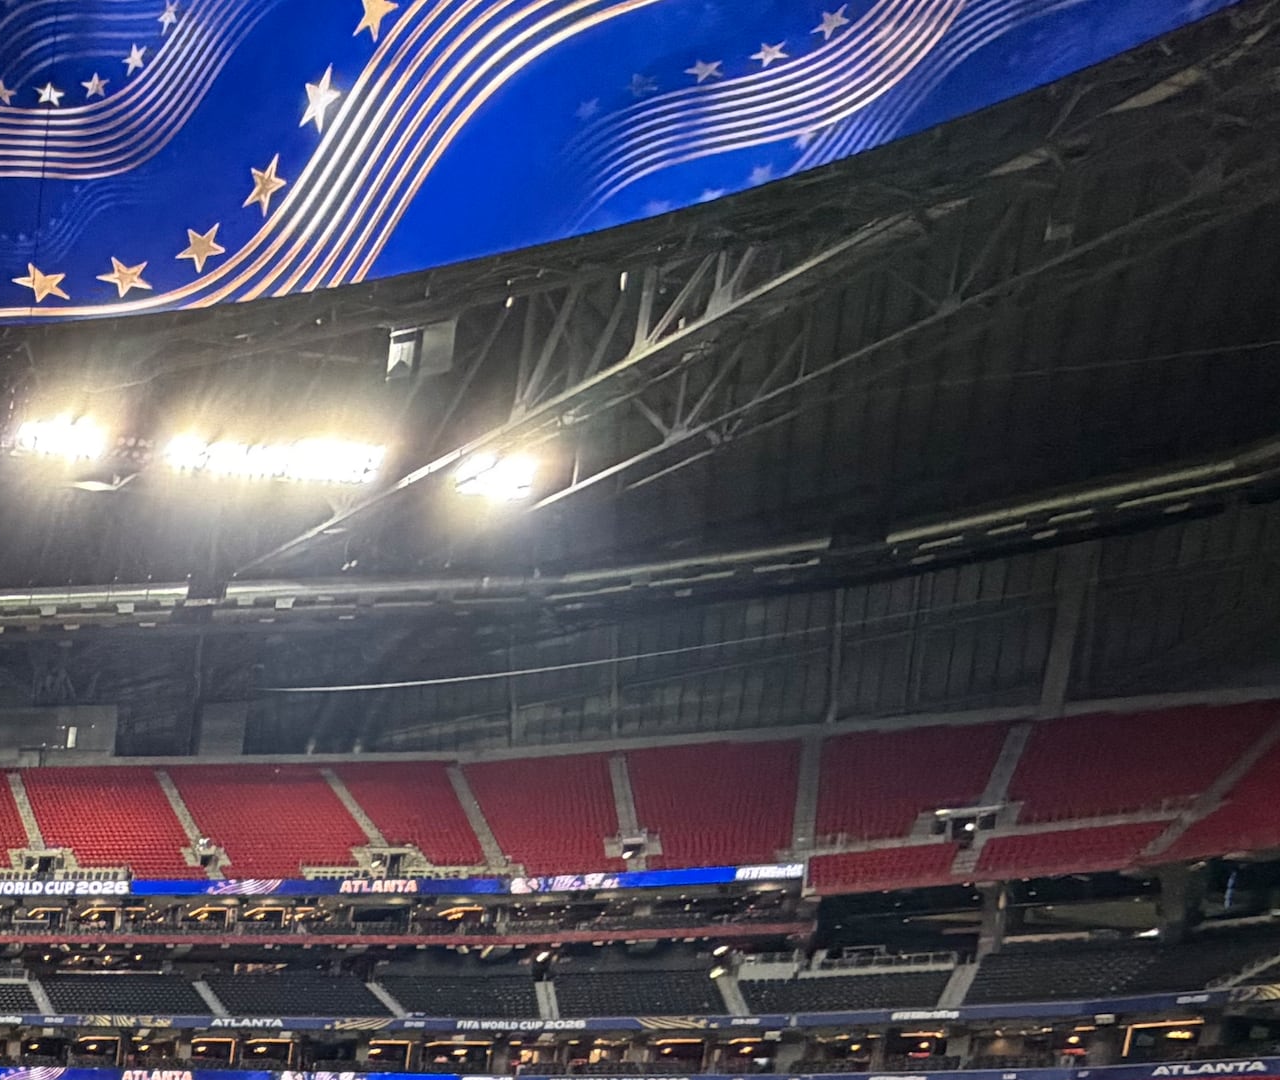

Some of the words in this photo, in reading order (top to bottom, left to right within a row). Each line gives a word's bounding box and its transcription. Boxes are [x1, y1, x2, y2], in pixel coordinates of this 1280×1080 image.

[44, 881, 75, 895] CUP
[75, 881, 130, 895] 2026
[339, 879, 418, 894] ATLANTA
[210, 1018, 284, 1028] ATLANTA
[456, 1020, 480, 1030] FIFA
[481, 1020, 518, 1030] WORLD
[520, 1020, 543, 1030] CUP
[1151, 1061, 1268, 1077] ATLANTA
